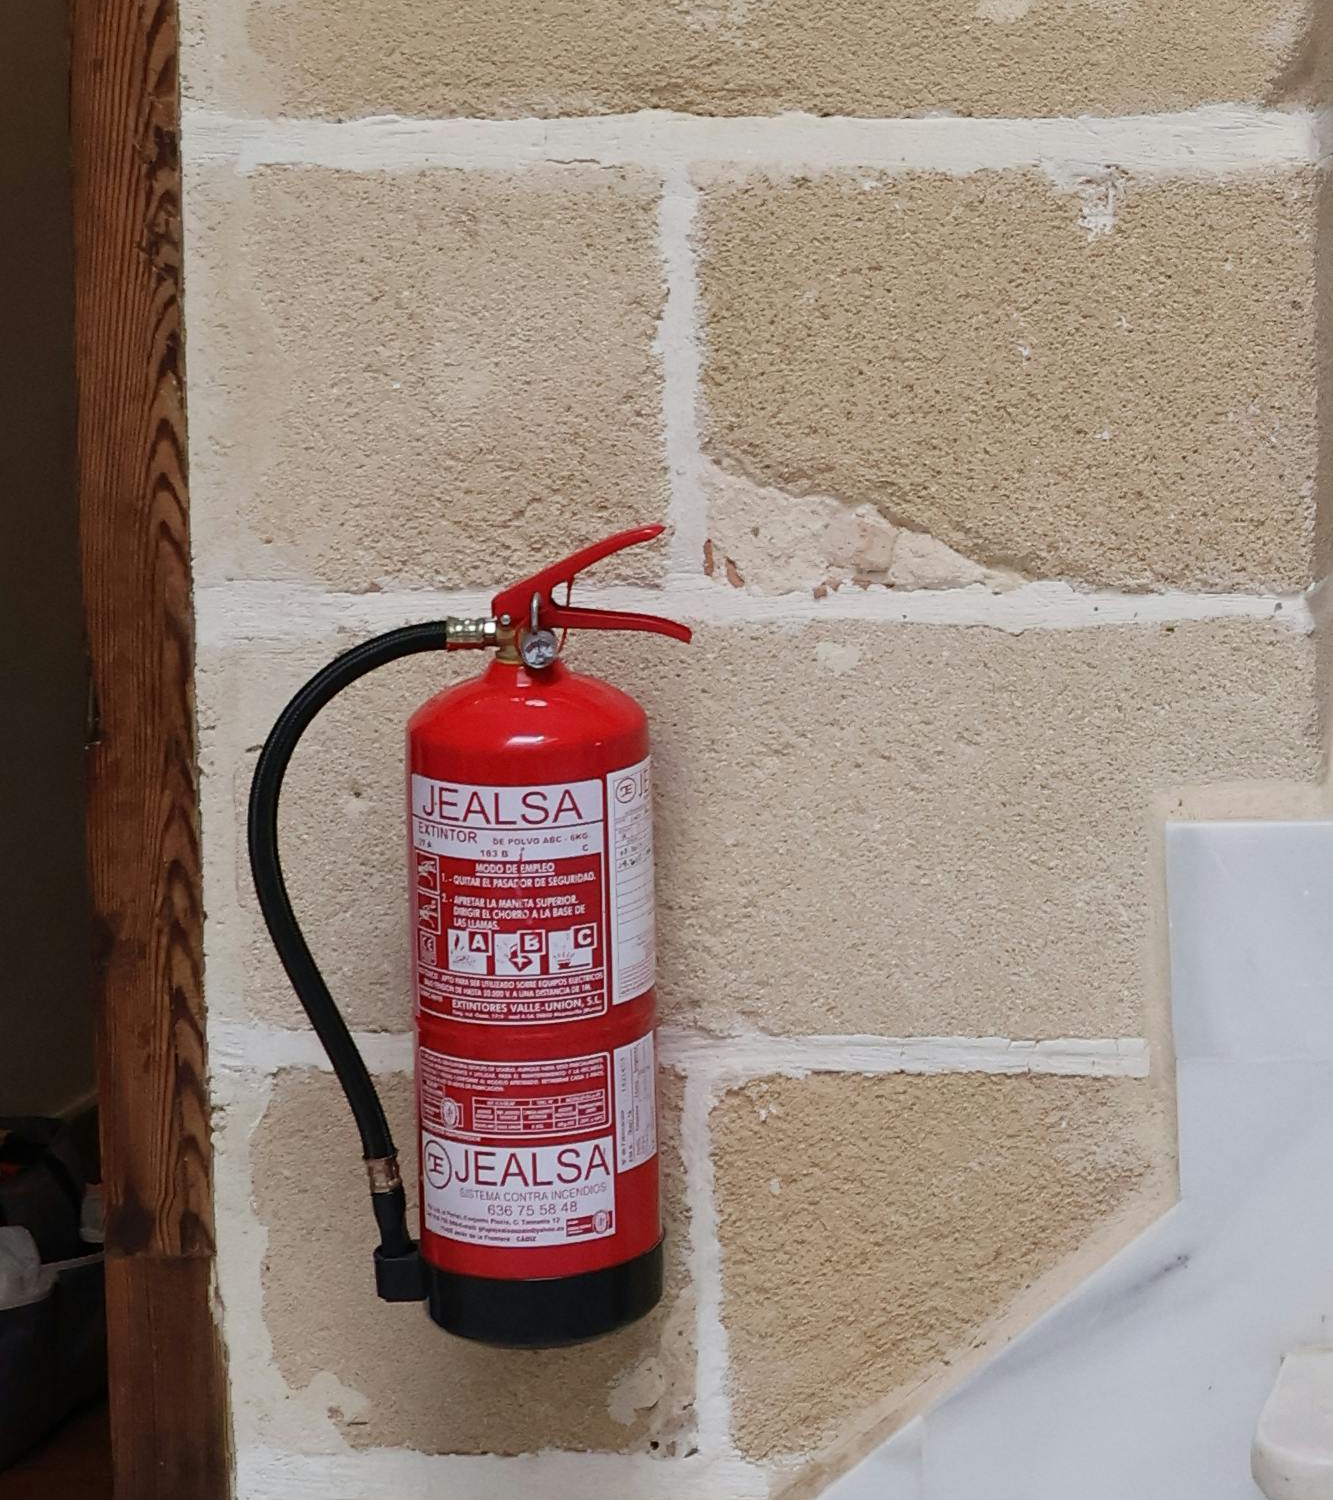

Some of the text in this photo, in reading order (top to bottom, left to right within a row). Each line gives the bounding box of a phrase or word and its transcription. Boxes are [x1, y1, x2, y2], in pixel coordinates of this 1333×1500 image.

[423, 785, 583, 825] JEALSA
[418, 821, 478, 844] EXTINTOR
[492, 838, 504, 846] DE
[508, 837, 540, 846] POLVO
[542, 835, 562, 844] ABC
[475, 862, 555, 874] MODO DE EMPLEO
[453, 875, 480, 885] QUITAR
[482, 878, 491, 888] EL
[534, 878, 546, 888] DE
[548, 871, 596, 886] SEGURIDAD.
[453, 896, 485, 907] APRETAR
[486, 898, 497, 908] LA
[498, 898, 534, 908] MANETA
[536, 895, 579, 908] SUPERIOR.
[453, 904, 586, 919] DIRIGIR EL CHORRO A LA BASE DE
[453, 917, 500, 929] LAS LLAMAS.
[471, 934, 486, 951] A
[525, 934, 540, 951] B
[577, 929, 592, 946] C
[512, 990, 518, 998] A
[452, 999, 508, 1013] EXTINTORES
[510, 998, 585, 1013] VALLE-UNION,
[455, 1144, 610, 1187] JEALSA
[459, 1181, 608, 1202] SISTEMA CONTRA INCENDIOS
[487, 1201, 578, 1217] 636 75 58 48
